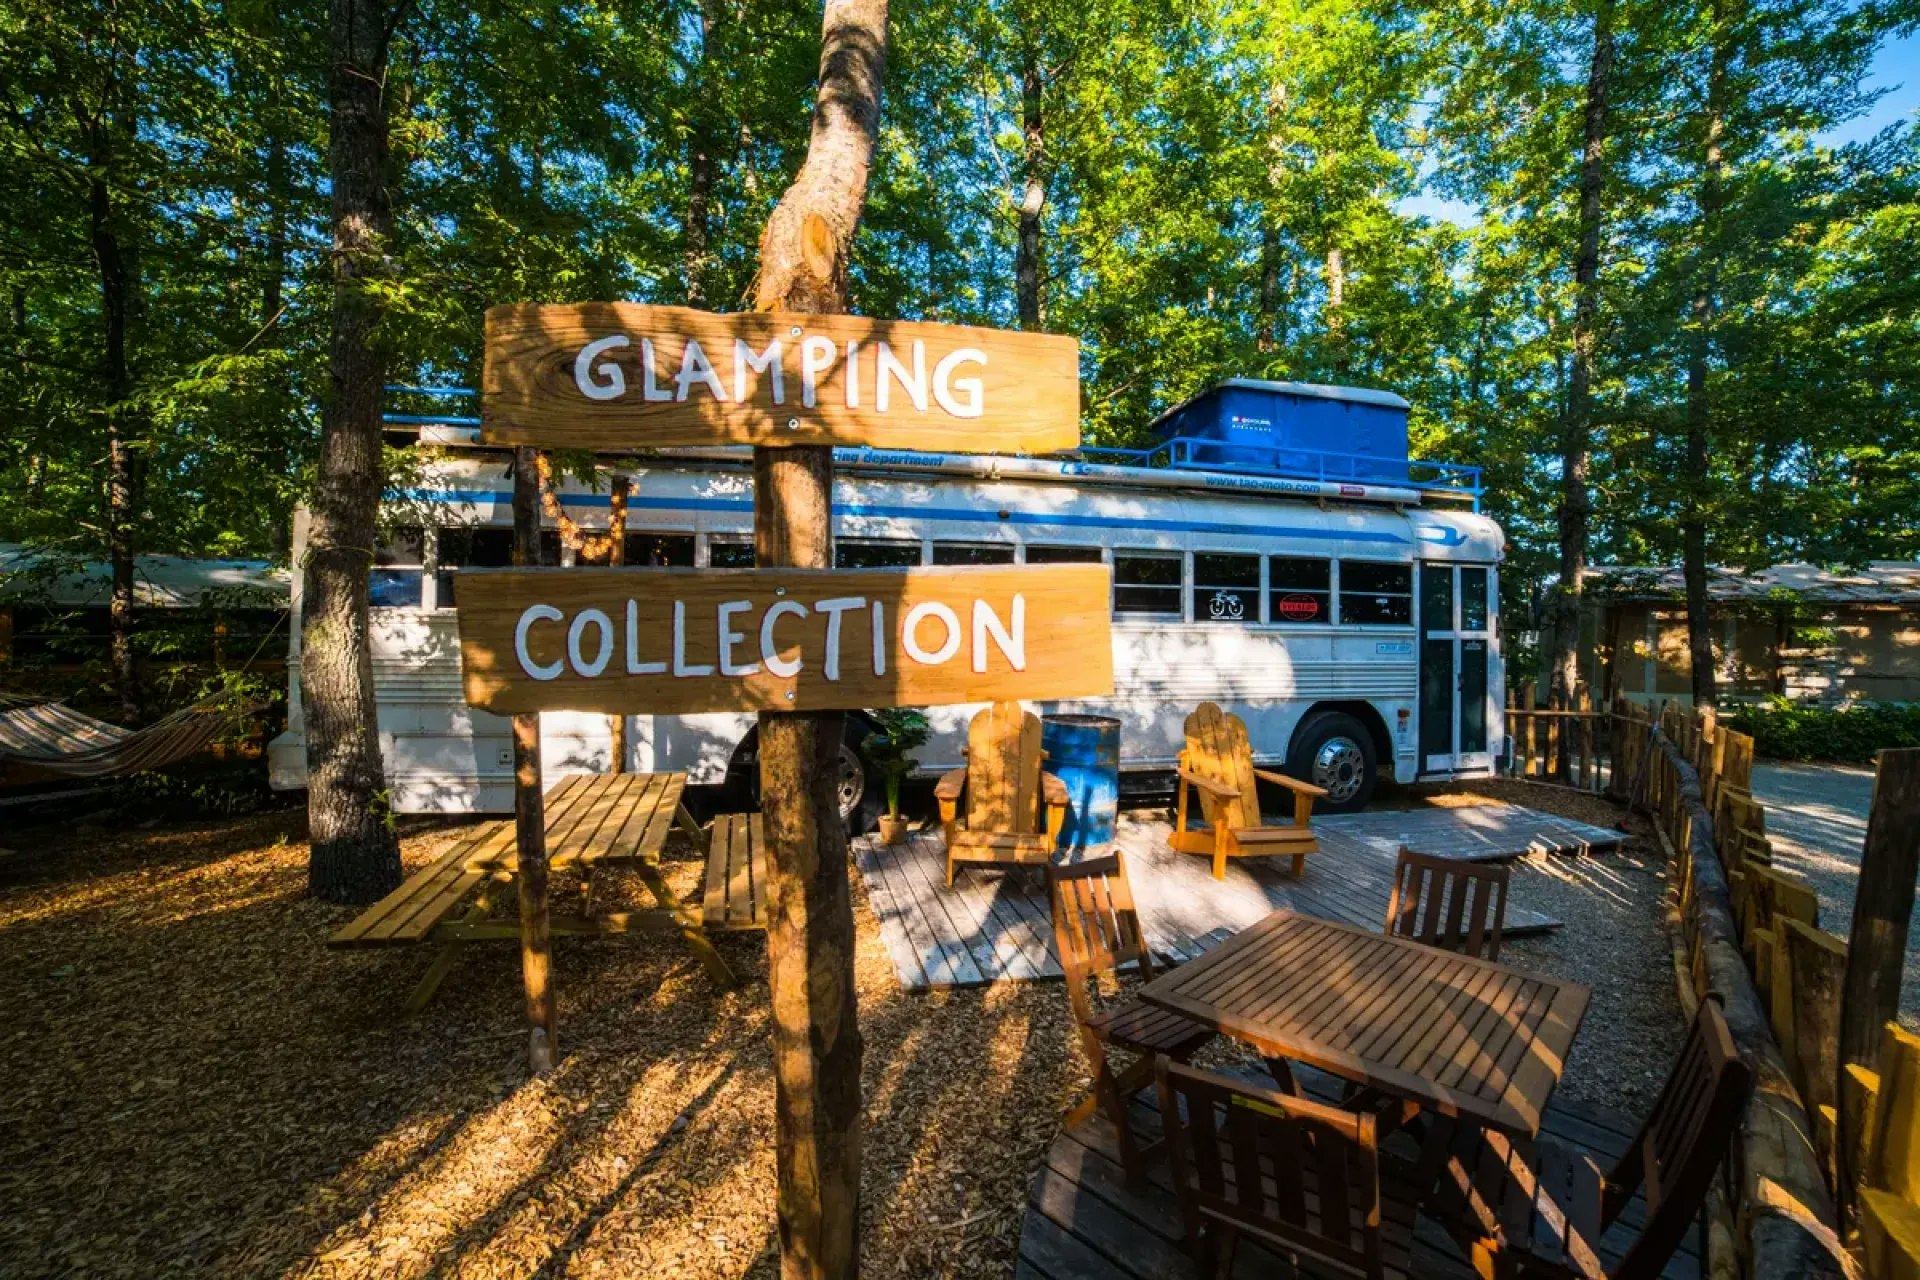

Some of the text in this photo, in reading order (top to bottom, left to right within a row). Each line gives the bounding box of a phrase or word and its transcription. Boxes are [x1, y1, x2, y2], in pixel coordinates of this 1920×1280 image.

[572, 334, 988, 419] GLAMPING
[863, 451, 943, 466] department
[513, 593, 1026, 681] COLLECTION
